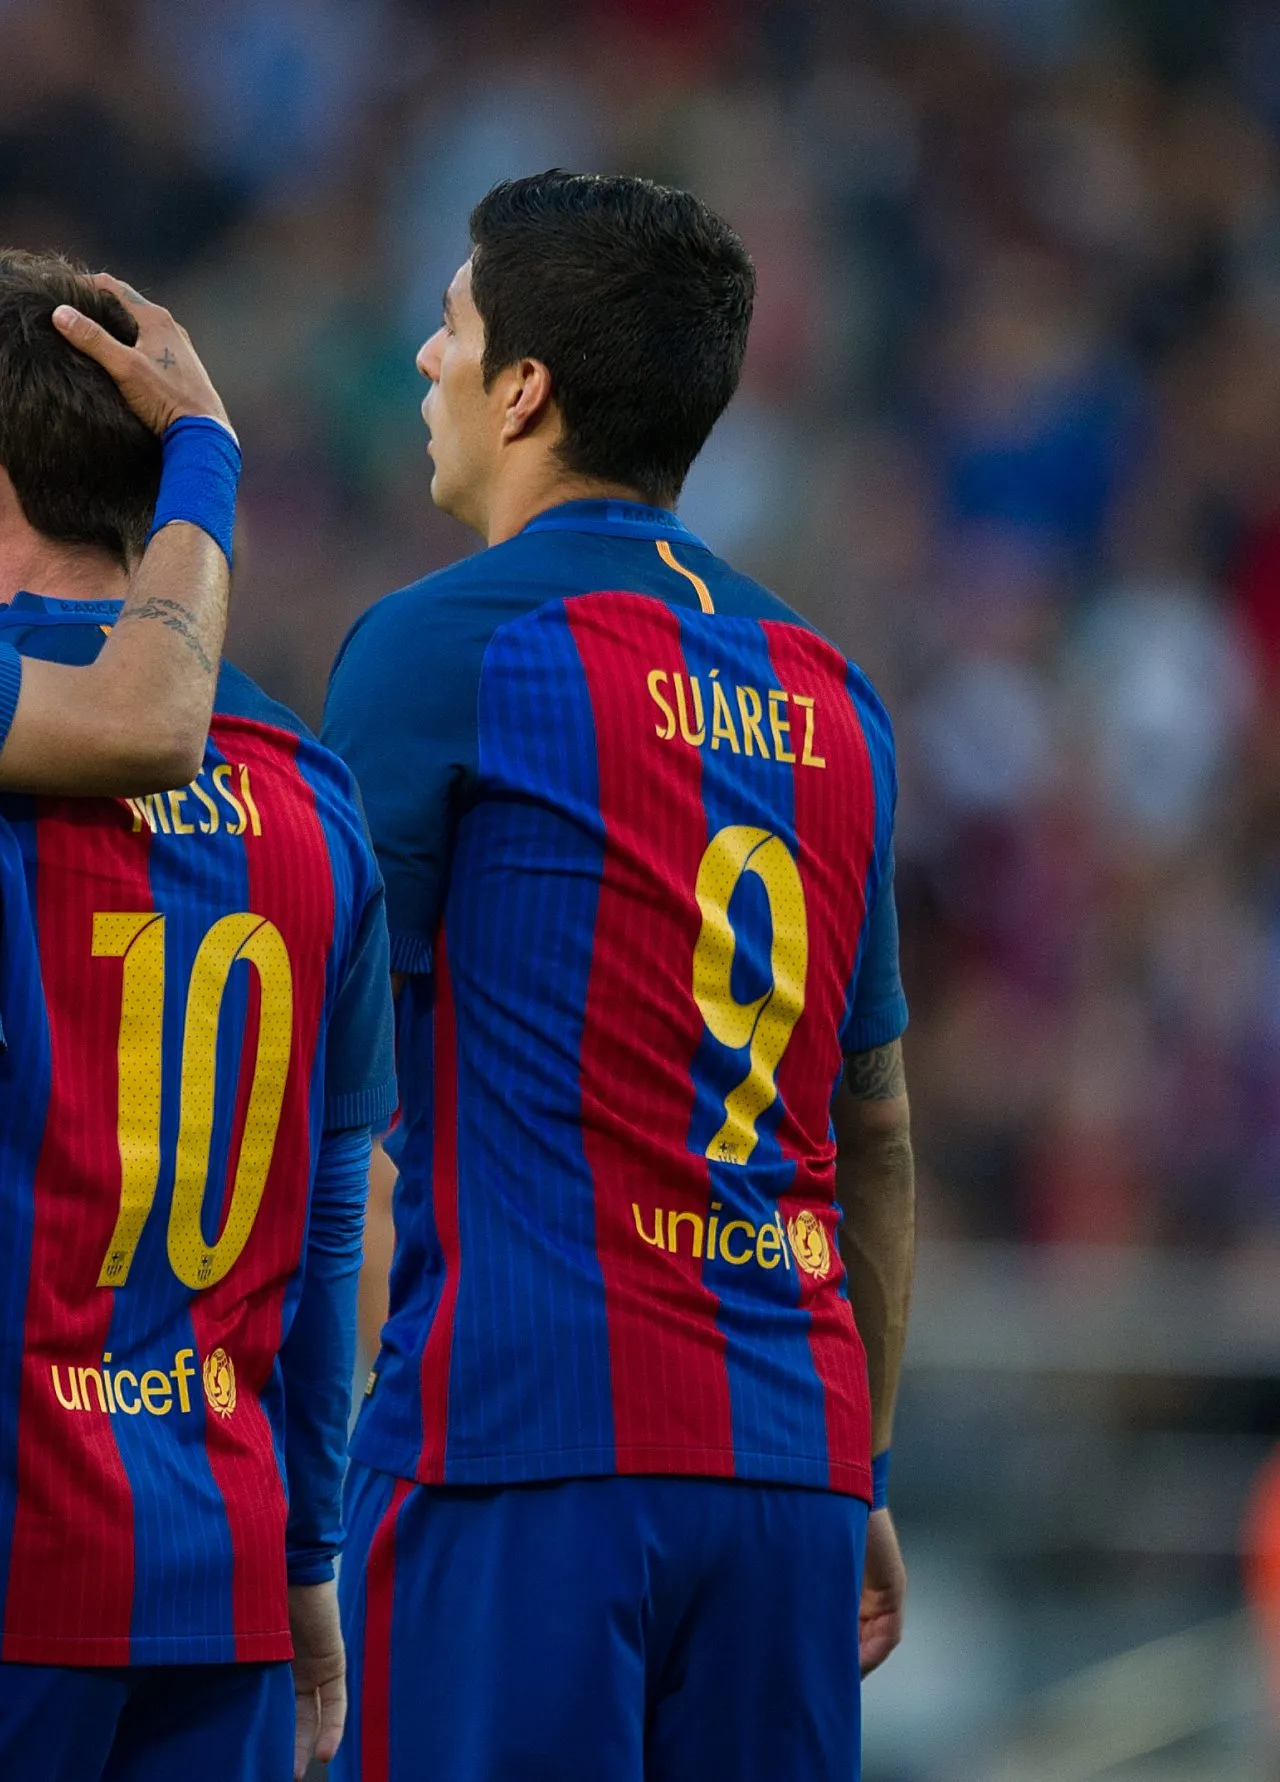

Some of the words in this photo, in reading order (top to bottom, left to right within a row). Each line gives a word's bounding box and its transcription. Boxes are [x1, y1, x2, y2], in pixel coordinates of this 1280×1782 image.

[647, 668, 826, 769] SUÁREZ
[91, 912, 293, 1290] 10
[692, 825, 808, 1166] 9
[51, 1349, 195, 1416] unicef
